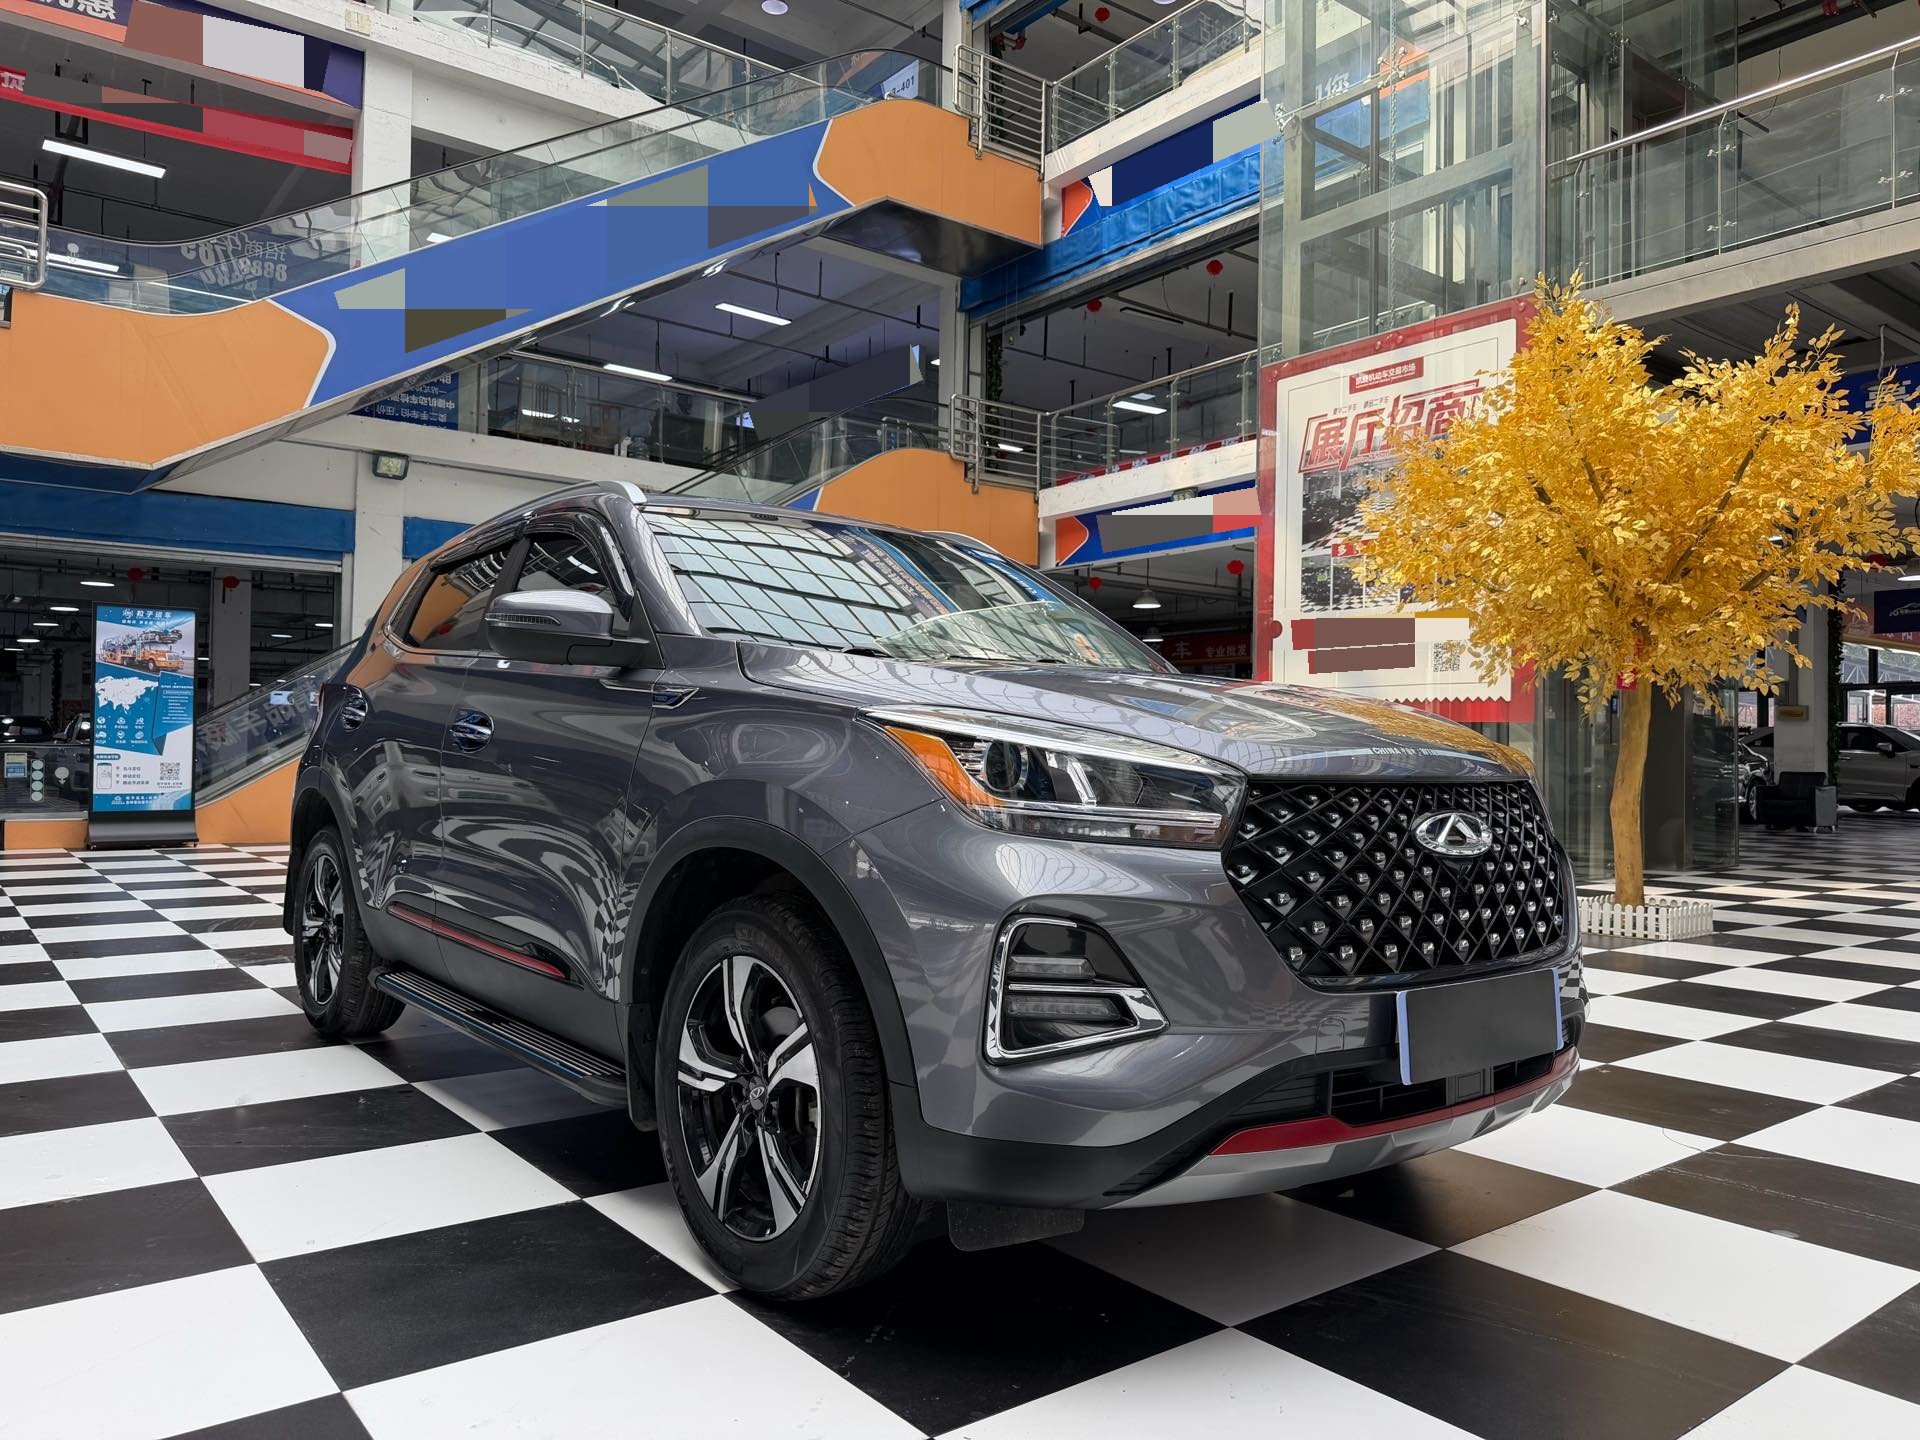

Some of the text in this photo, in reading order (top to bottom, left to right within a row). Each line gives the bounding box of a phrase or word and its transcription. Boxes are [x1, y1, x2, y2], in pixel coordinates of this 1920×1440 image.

[1308, 386, 1485, 471] 展厅招商
[1372, 747, 1402, 755] CHINA
